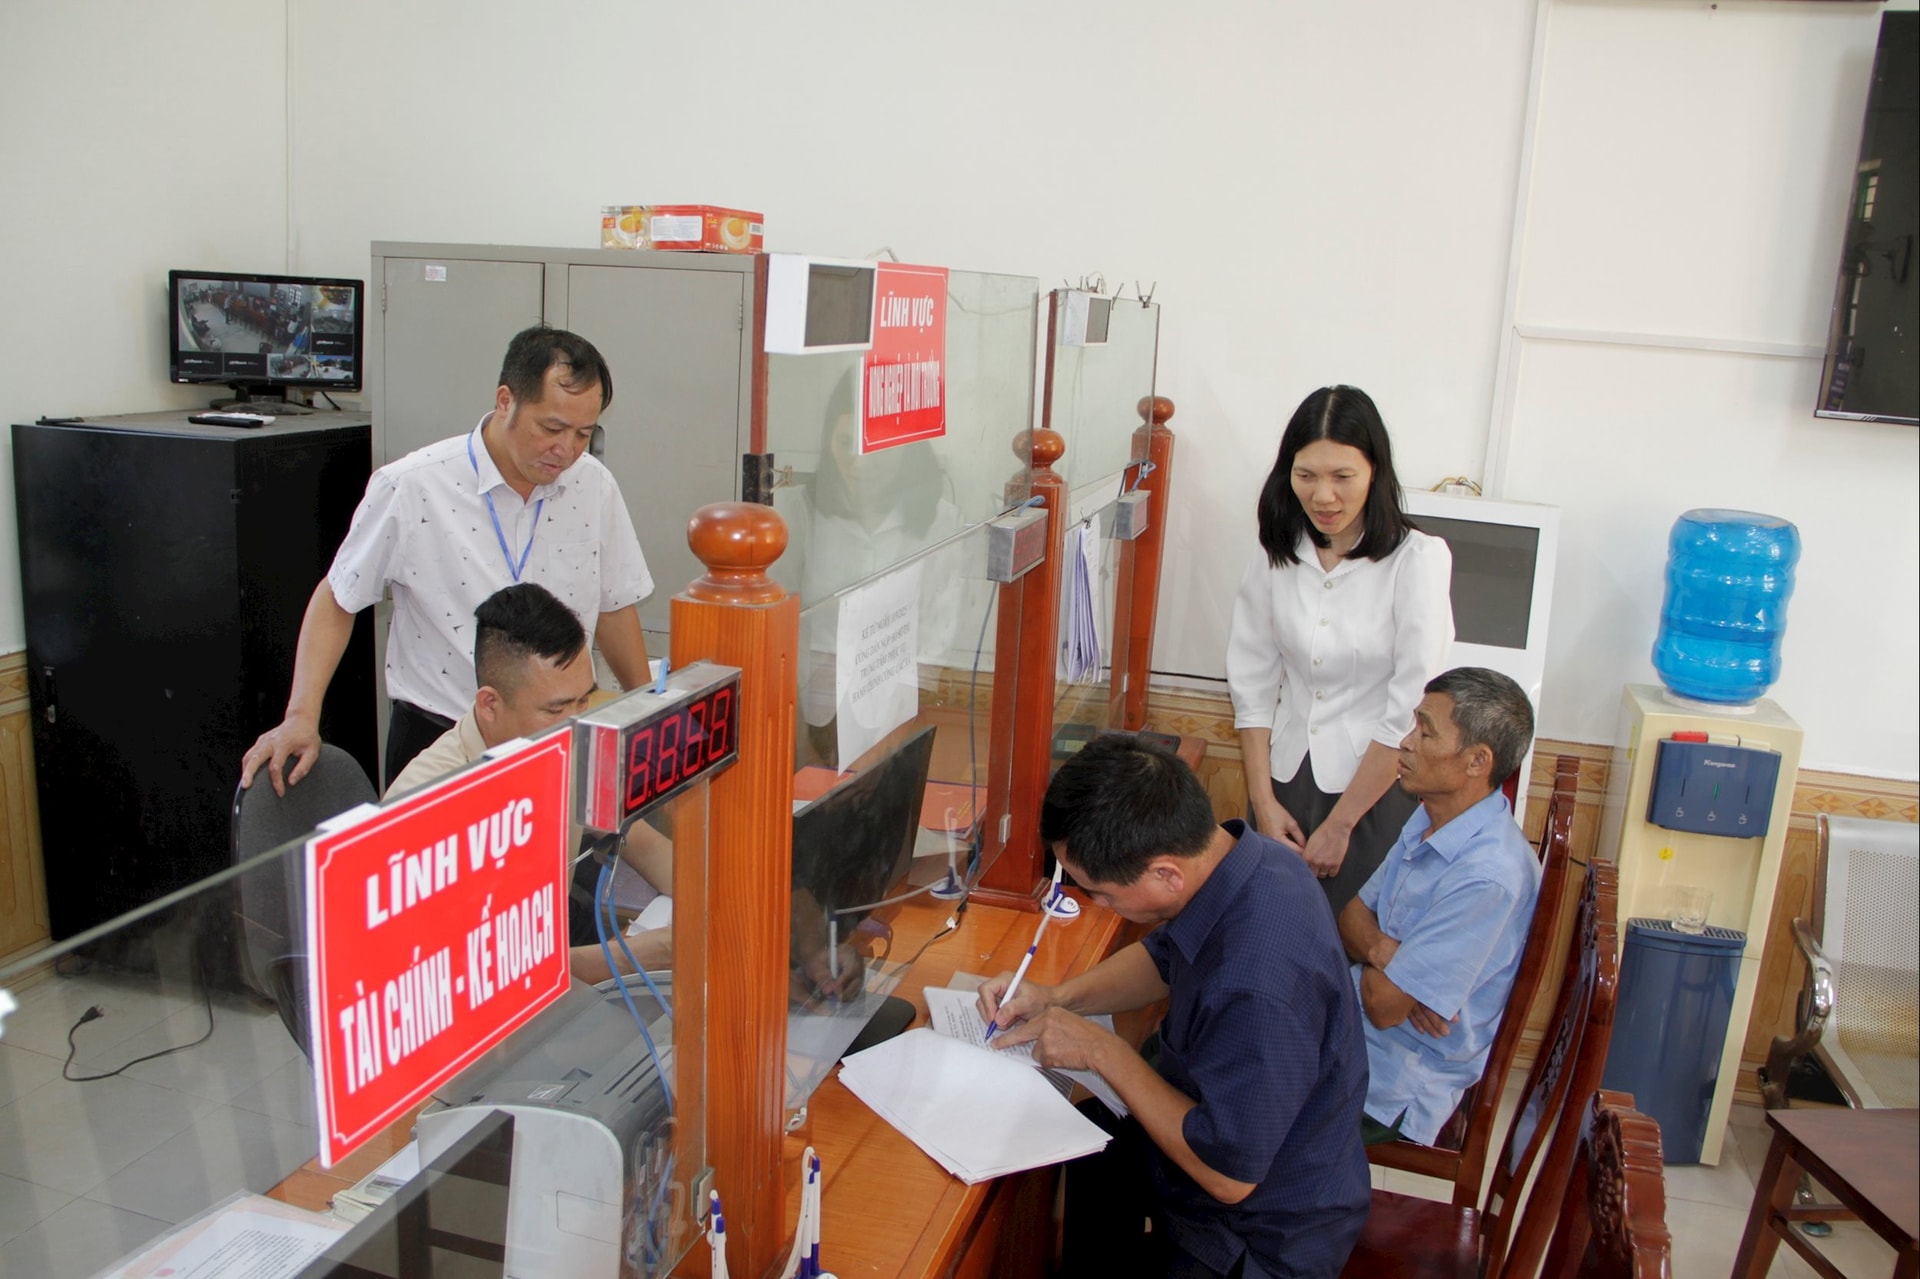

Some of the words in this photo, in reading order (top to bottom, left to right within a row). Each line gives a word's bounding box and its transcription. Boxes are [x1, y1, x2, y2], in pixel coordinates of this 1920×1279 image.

[880, 291, 910, 328] LĨNH
[912, 295, 934, 333] VỰC
[366, 833, 458, 930] LĨNH
[467, 797, 533, 870] VỰC
[339, 980, 383, 1095] TÀI
[384, 945, 453, 1066] CHÍNH
[467, 893, 495, 1011] KẾ
[495, 881, 555, 990] HOẠCH
